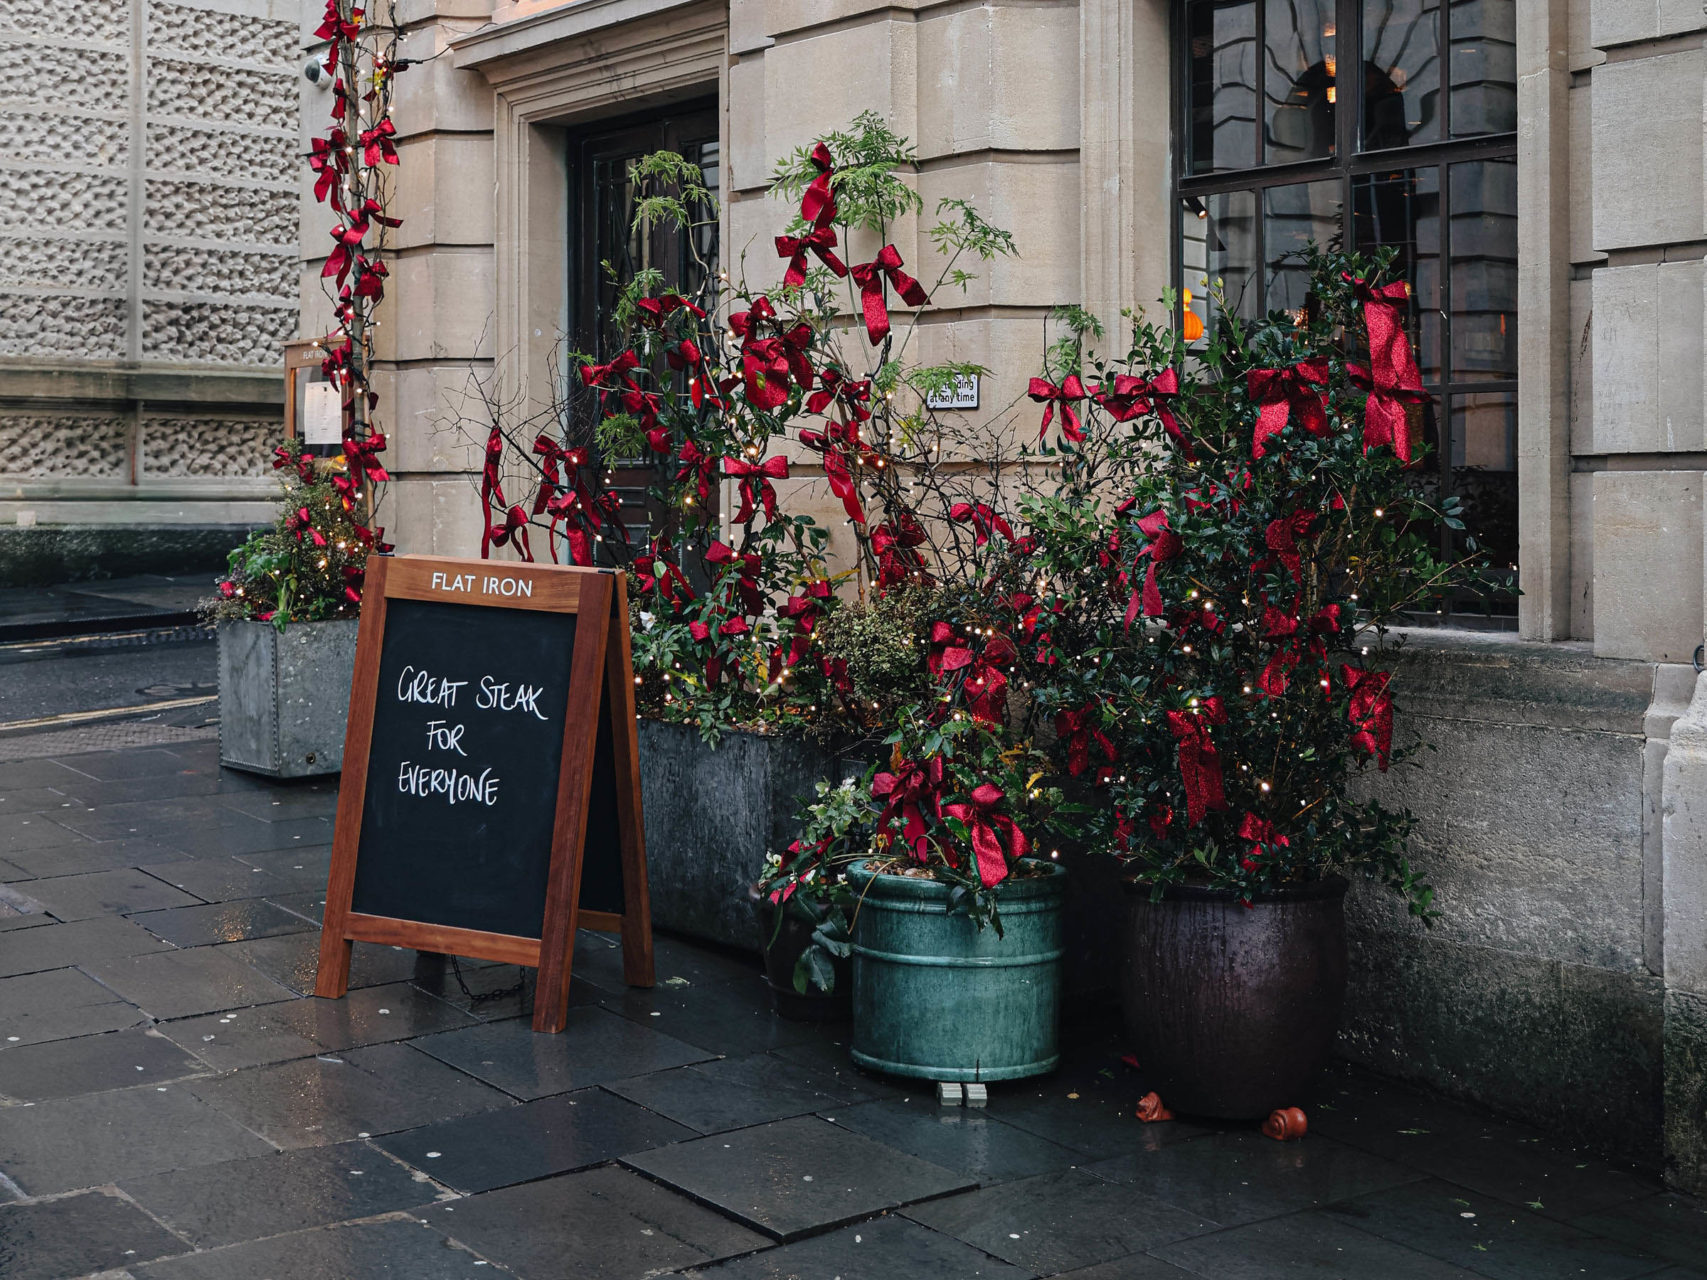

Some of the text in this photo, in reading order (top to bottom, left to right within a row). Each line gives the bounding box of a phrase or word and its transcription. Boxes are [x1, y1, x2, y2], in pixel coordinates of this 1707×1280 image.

[930, 392, 975, 404] at any time
[431, 572, 533, 598] FLAT IRON
[398, 665, 549, 721] GREAT STEAK
[426, 720, 468, 757] FOR
[398, 761, 500, 806] EVERYONE
